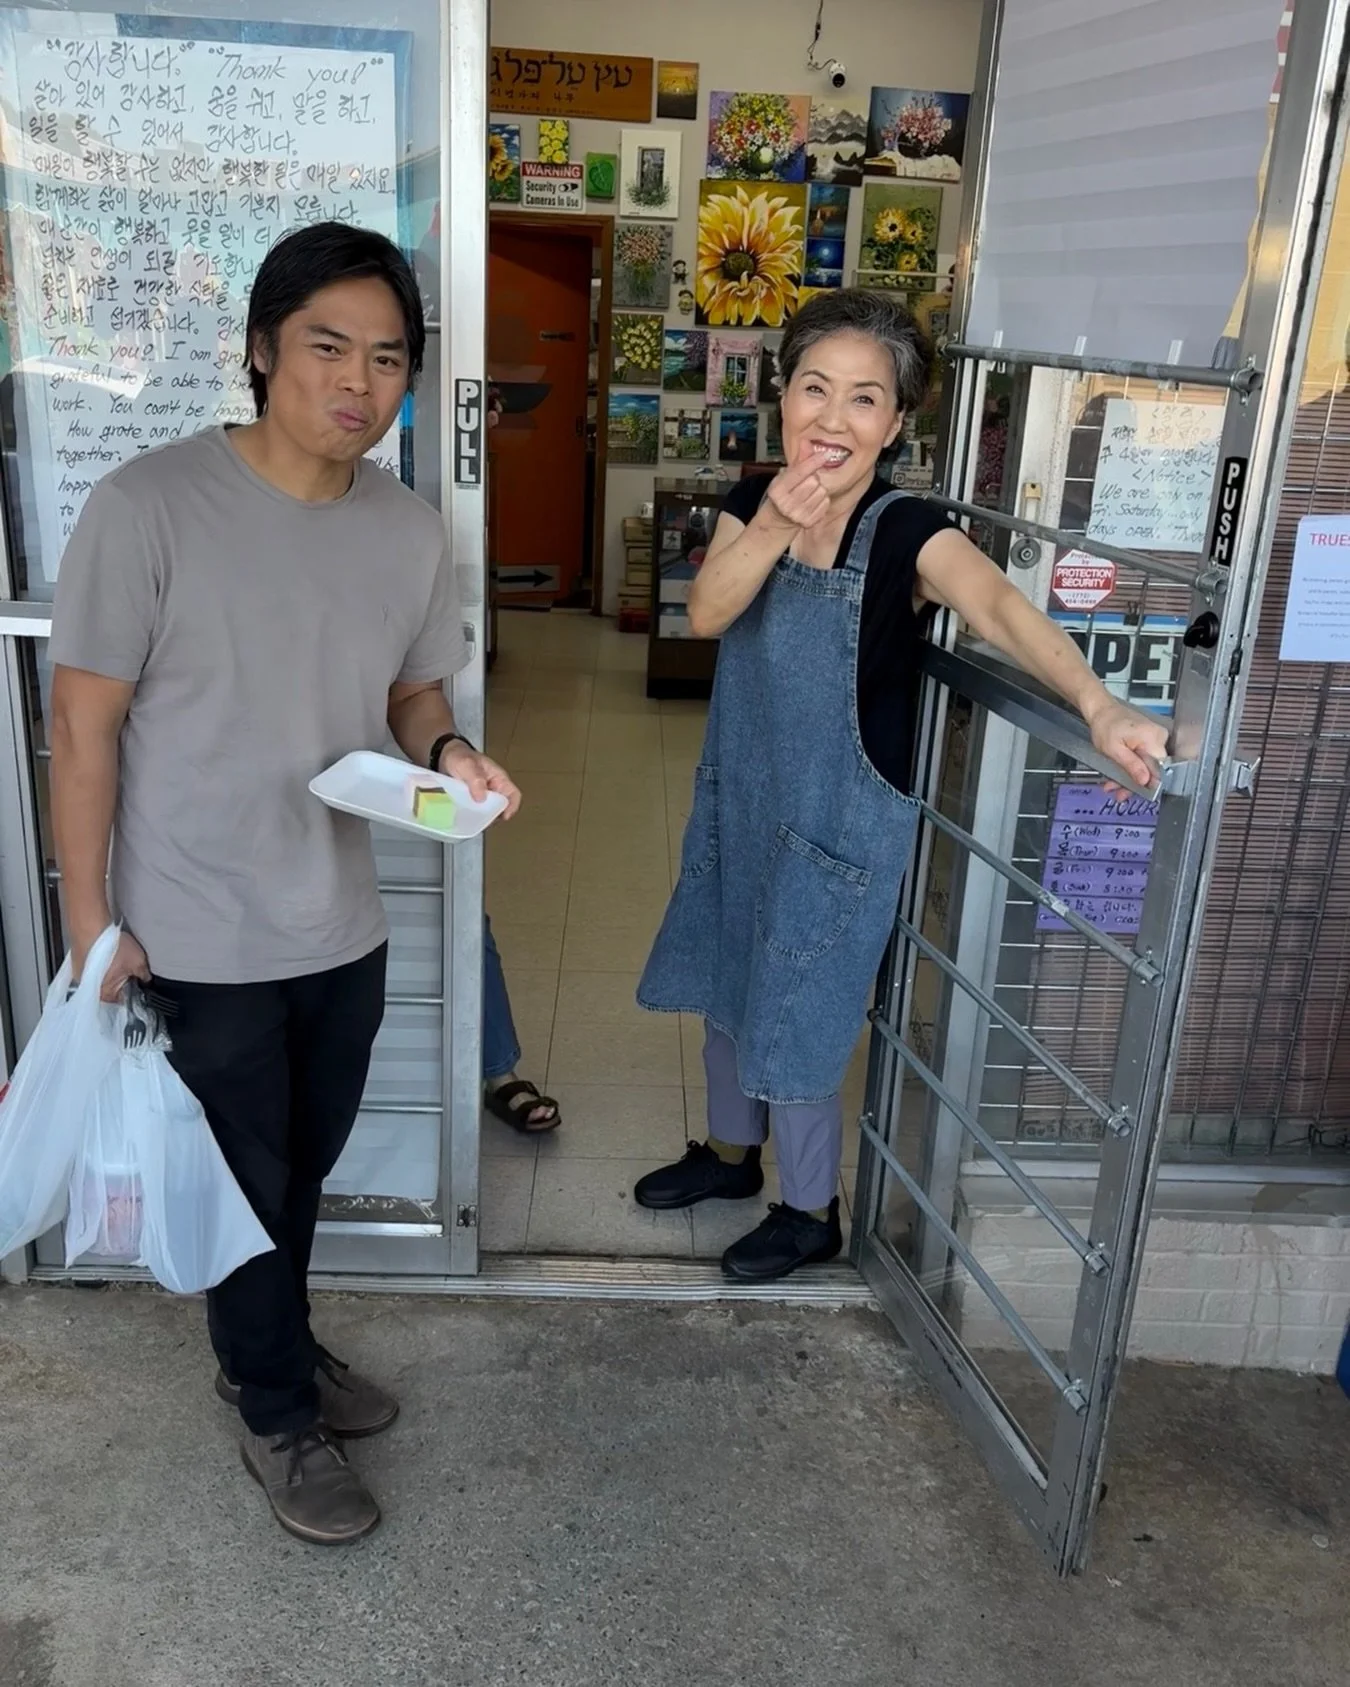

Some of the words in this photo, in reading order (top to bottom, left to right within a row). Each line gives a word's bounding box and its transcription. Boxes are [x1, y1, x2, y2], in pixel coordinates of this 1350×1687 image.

[34, 79, 66, 111] 살아
[75, 80, 105, 108] 있어
[75, 113, 96, 146] 할
[102, 114, 122, 147] 수
[141, 118, 184, 146] 있어서
[525, 163, 581, 178] WARNING
[526, 180, 556, 195] Security
[526, 193, 556, 206] Cameras
[566, 196, 579, 207] Use
[193, 251, 262, 278] 기도합니
[48, 335, 99, 357] Thank
[165, 341, 186, 360] I
[49, 362, 113, 389] grateful
[120, 369, 138, 386] to
[143, 368, 164, 387] be
[171, 372, 200, 390] able
[205, 373, 224, 391] to
[109, 393, 134, 414] You
[184, 400, 206, 417] be
[66, 418, 94, 438] How
[149, 420, 184, 441] and
[457, 380, 479, 483] PULL
[56, 445, 123, 469] together.
[1099, 483, 1122, 500] We
[1127, 487, 1150, 500] are
[60, 501, 74, 516] to
[1215, 462, 1240, 560] PUSH
[1088, 519, 1117, 541] days
[1309, 532, 1350, 547] TRUE
[1056, 567, 1112, 578] PROTECTION
[1061, 577, 1105, 588] SECURITY
